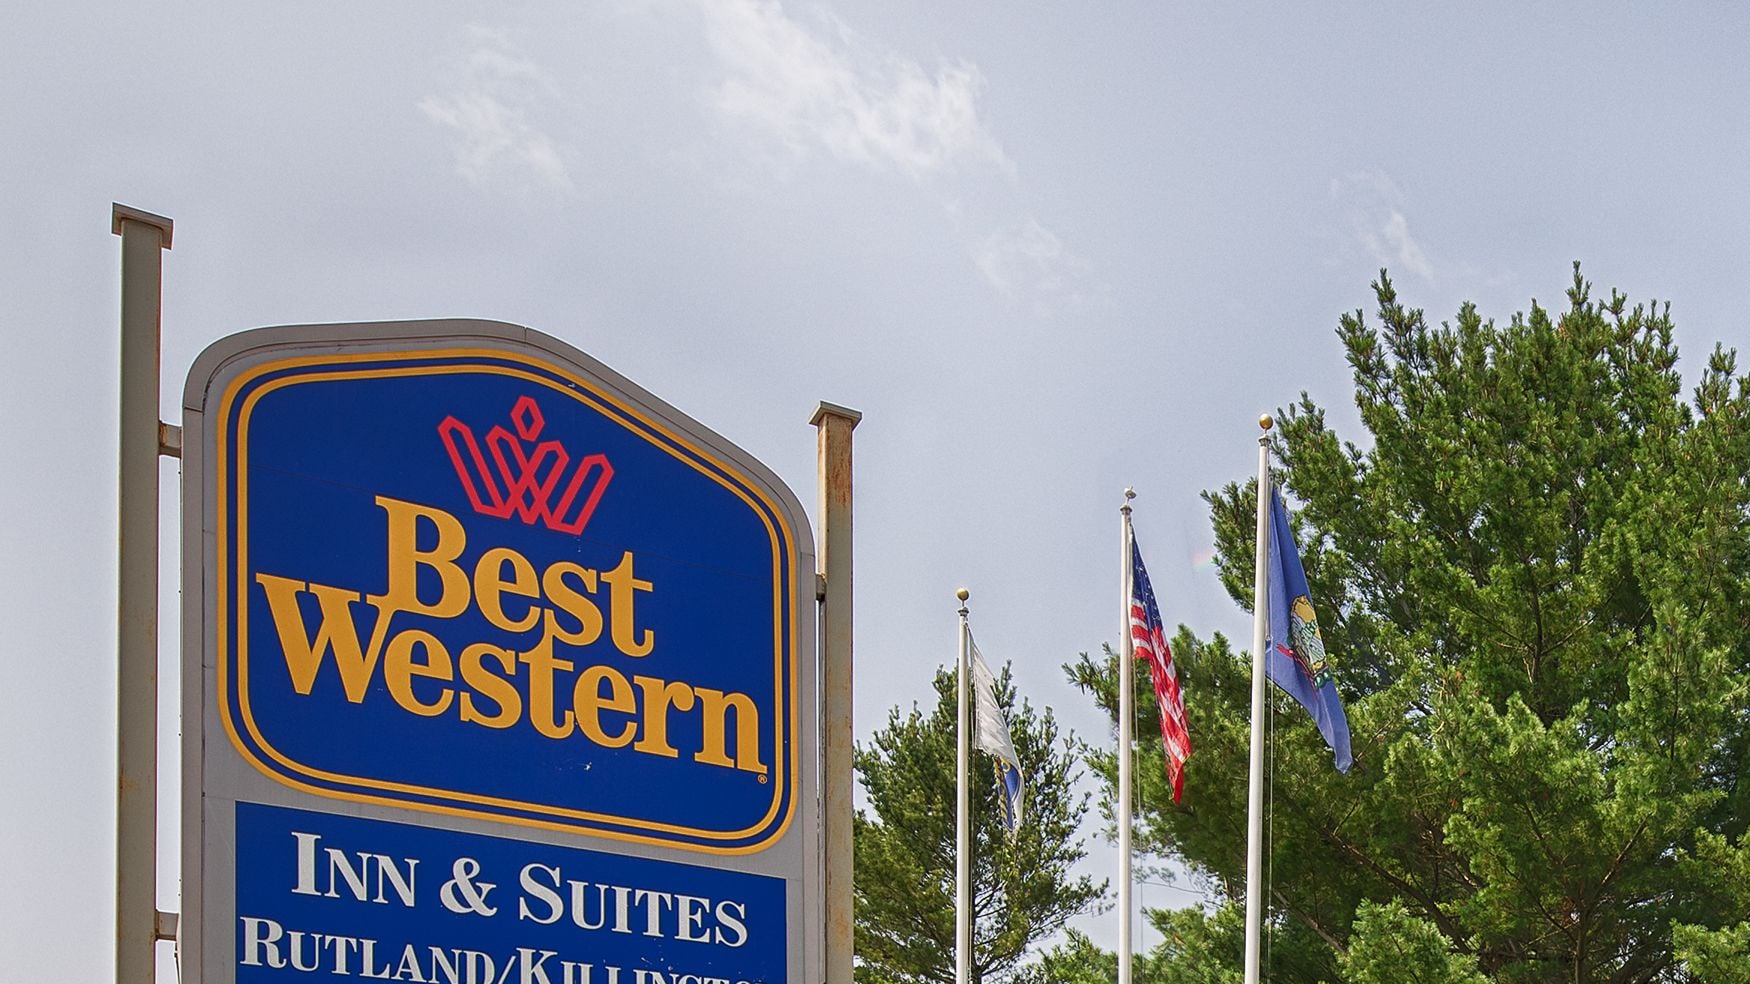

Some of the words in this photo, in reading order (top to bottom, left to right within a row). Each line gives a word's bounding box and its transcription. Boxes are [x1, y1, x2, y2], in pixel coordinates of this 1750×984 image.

[375, 495, 654, 658] Best
[256, 572, 768, 774] Western
[291, 832, 419, 907] INN
[440, 857, 498, 917] &
[518, 864, 749, 948] SUITES
